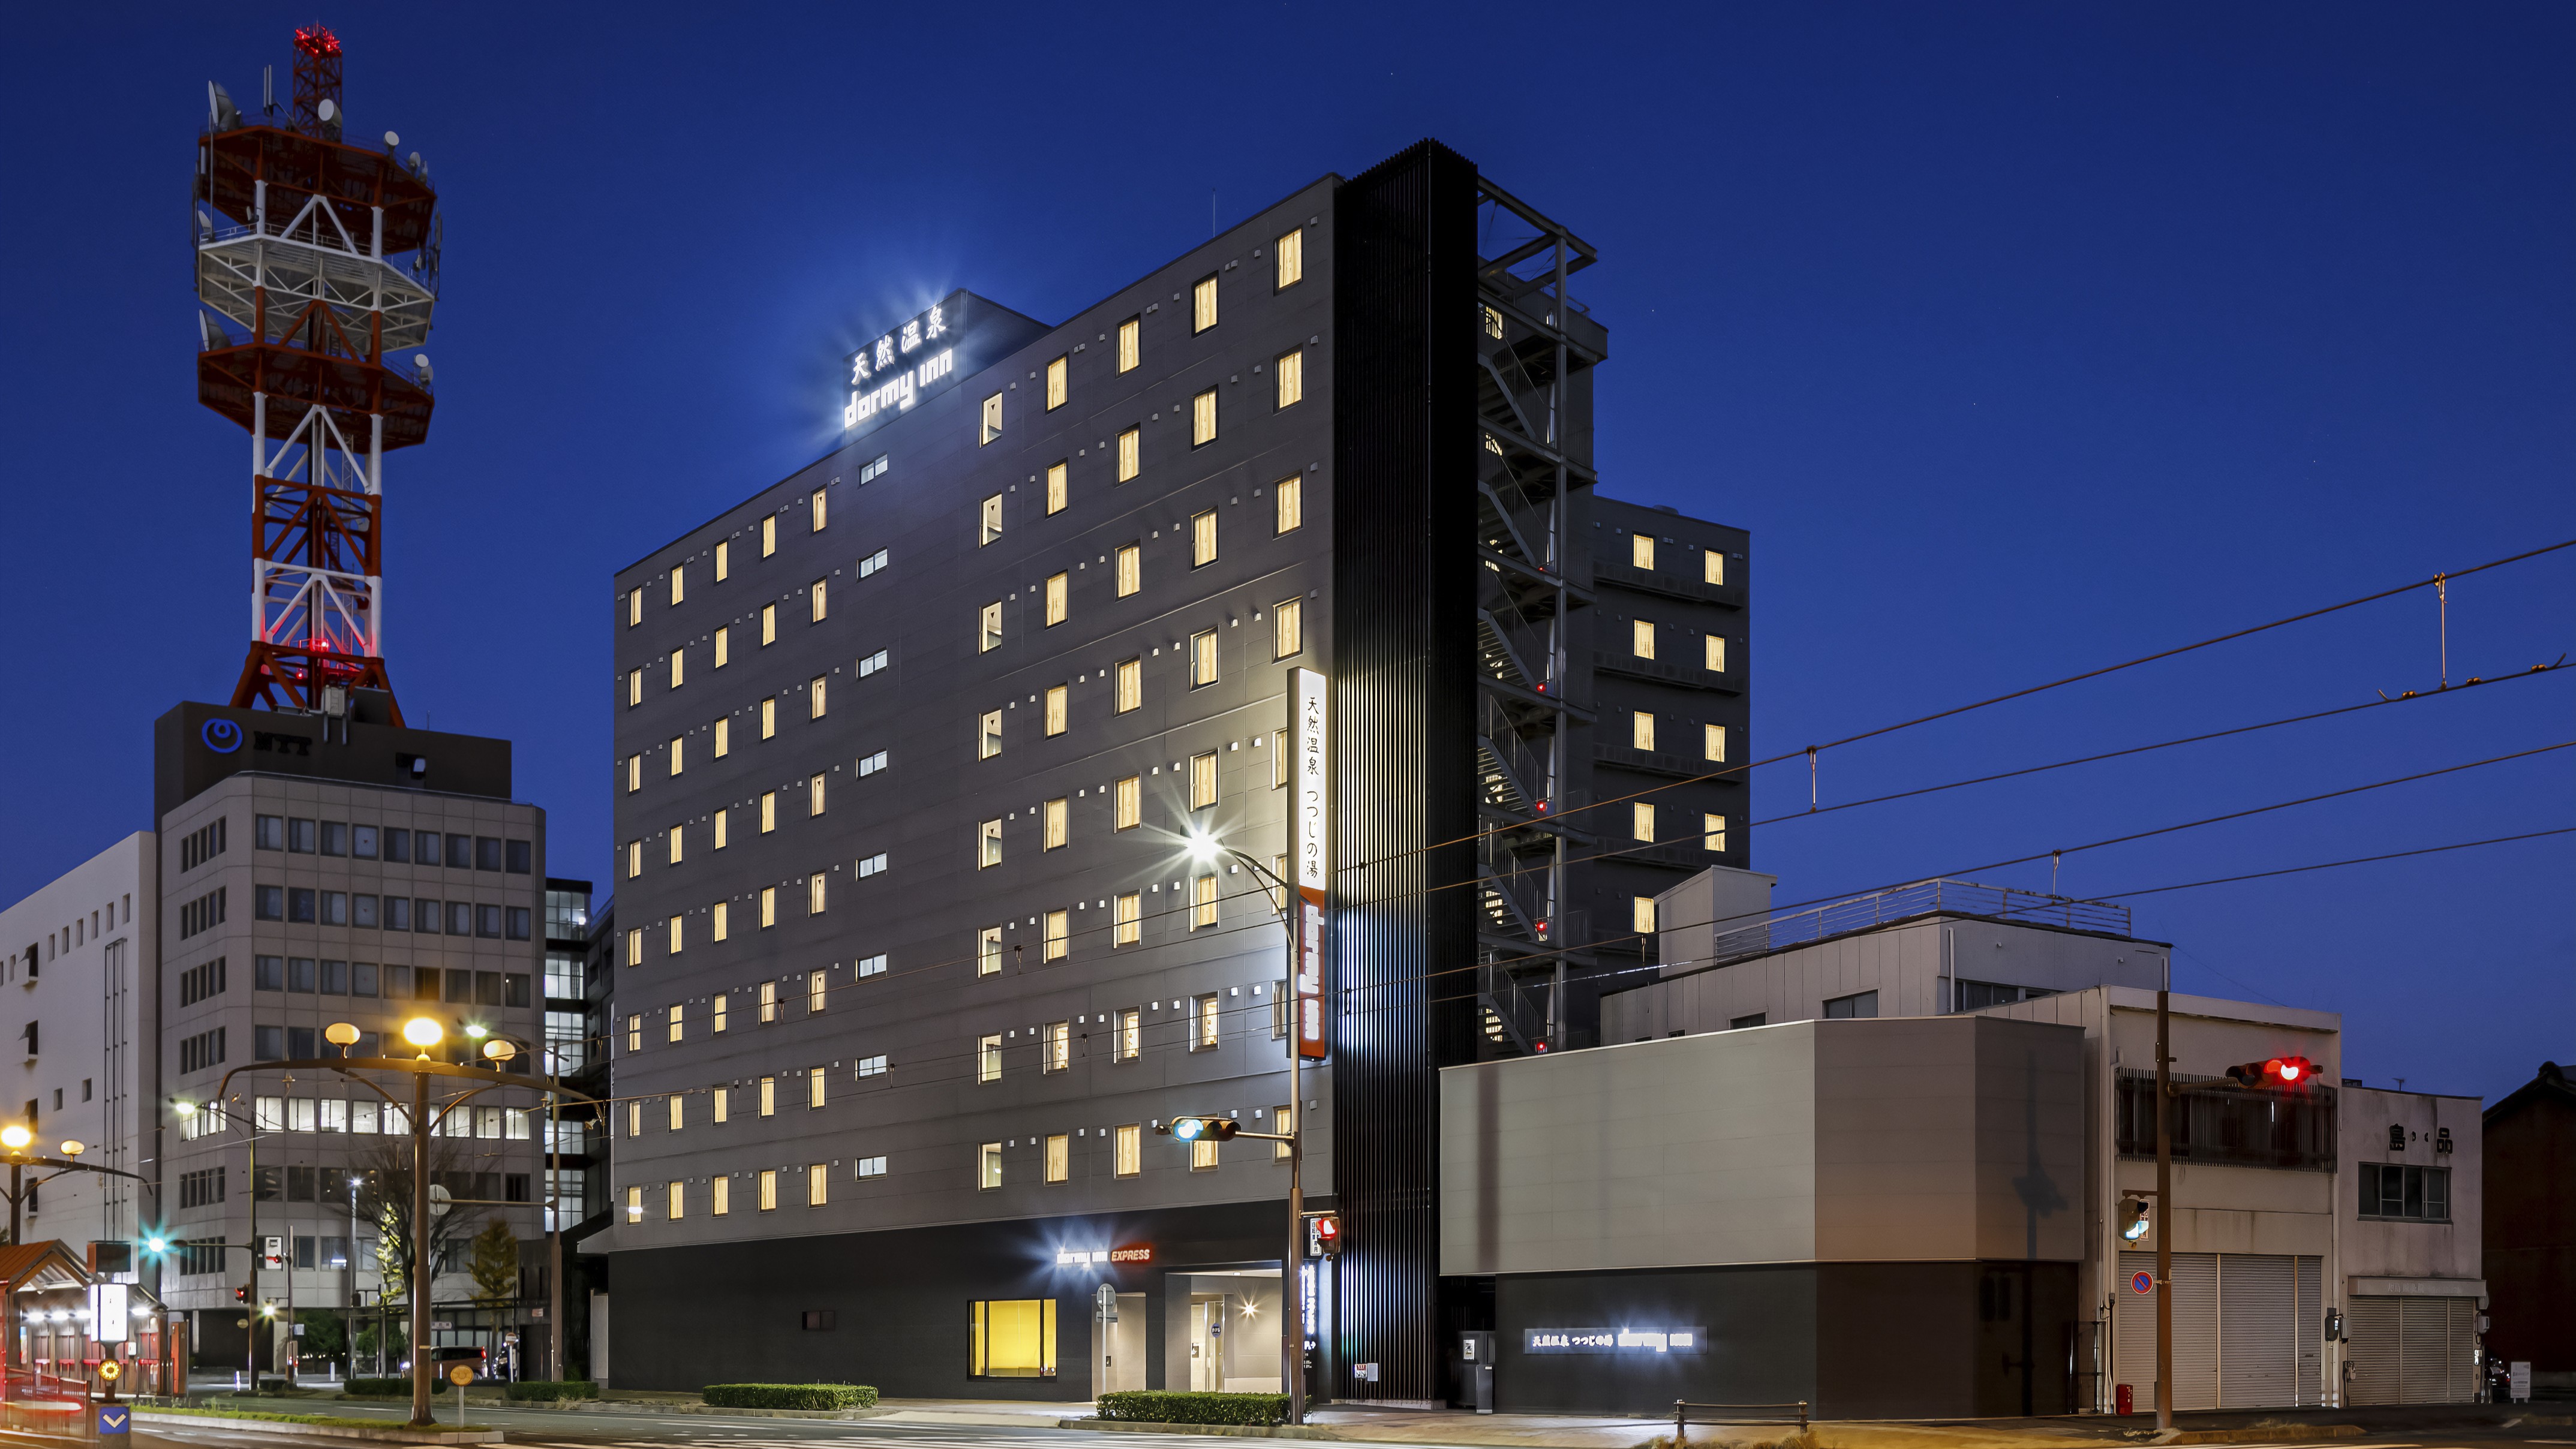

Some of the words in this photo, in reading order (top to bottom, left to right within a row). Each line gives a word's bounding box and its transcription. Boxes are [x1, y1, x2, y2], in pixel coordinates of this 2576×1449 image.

[851, 306, 946, 385] 天然温泉
[844, 371, 915, 428] dormy
[919, 348, 952, 387] inn
[253, 730, 312, 756] NTT
[1307, 697, 1319, 775] 天然温泉
[1307, 790, 1319, 879] つつじの湯
[1111, 1249, 1150, 1262] EXPRESS
